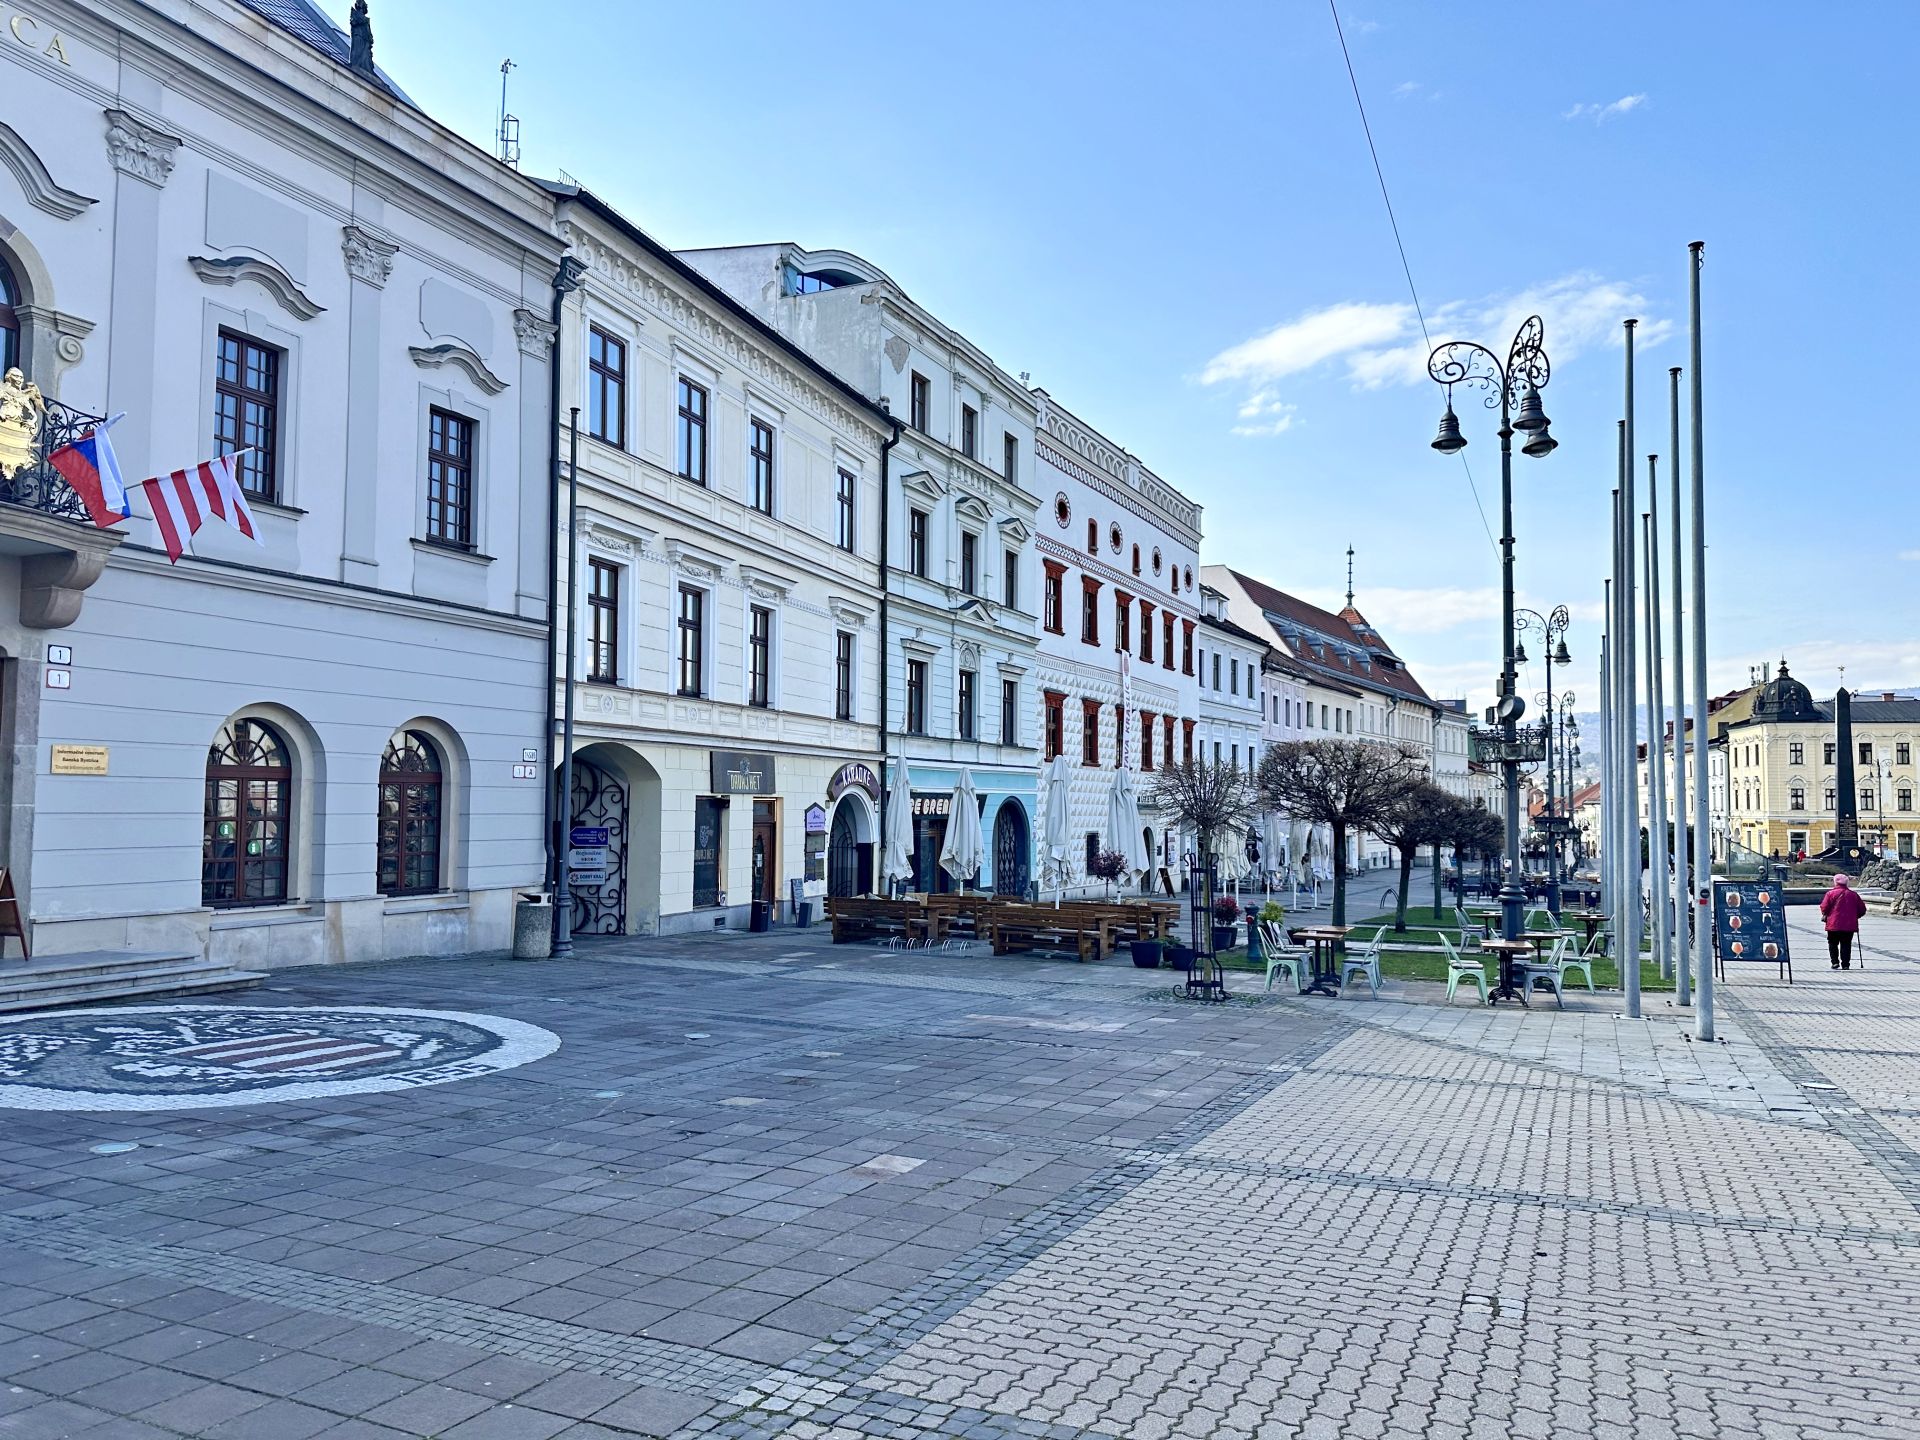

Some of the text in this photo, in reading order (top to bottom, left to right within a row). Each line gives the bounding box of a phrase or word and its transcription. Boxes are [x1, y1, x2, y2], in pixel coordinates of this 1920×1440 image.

[0, 10, 71, 67] CA
[841, 766, 871, 787] KARAOKE
[381, 1062, 500, 1085] 1255
